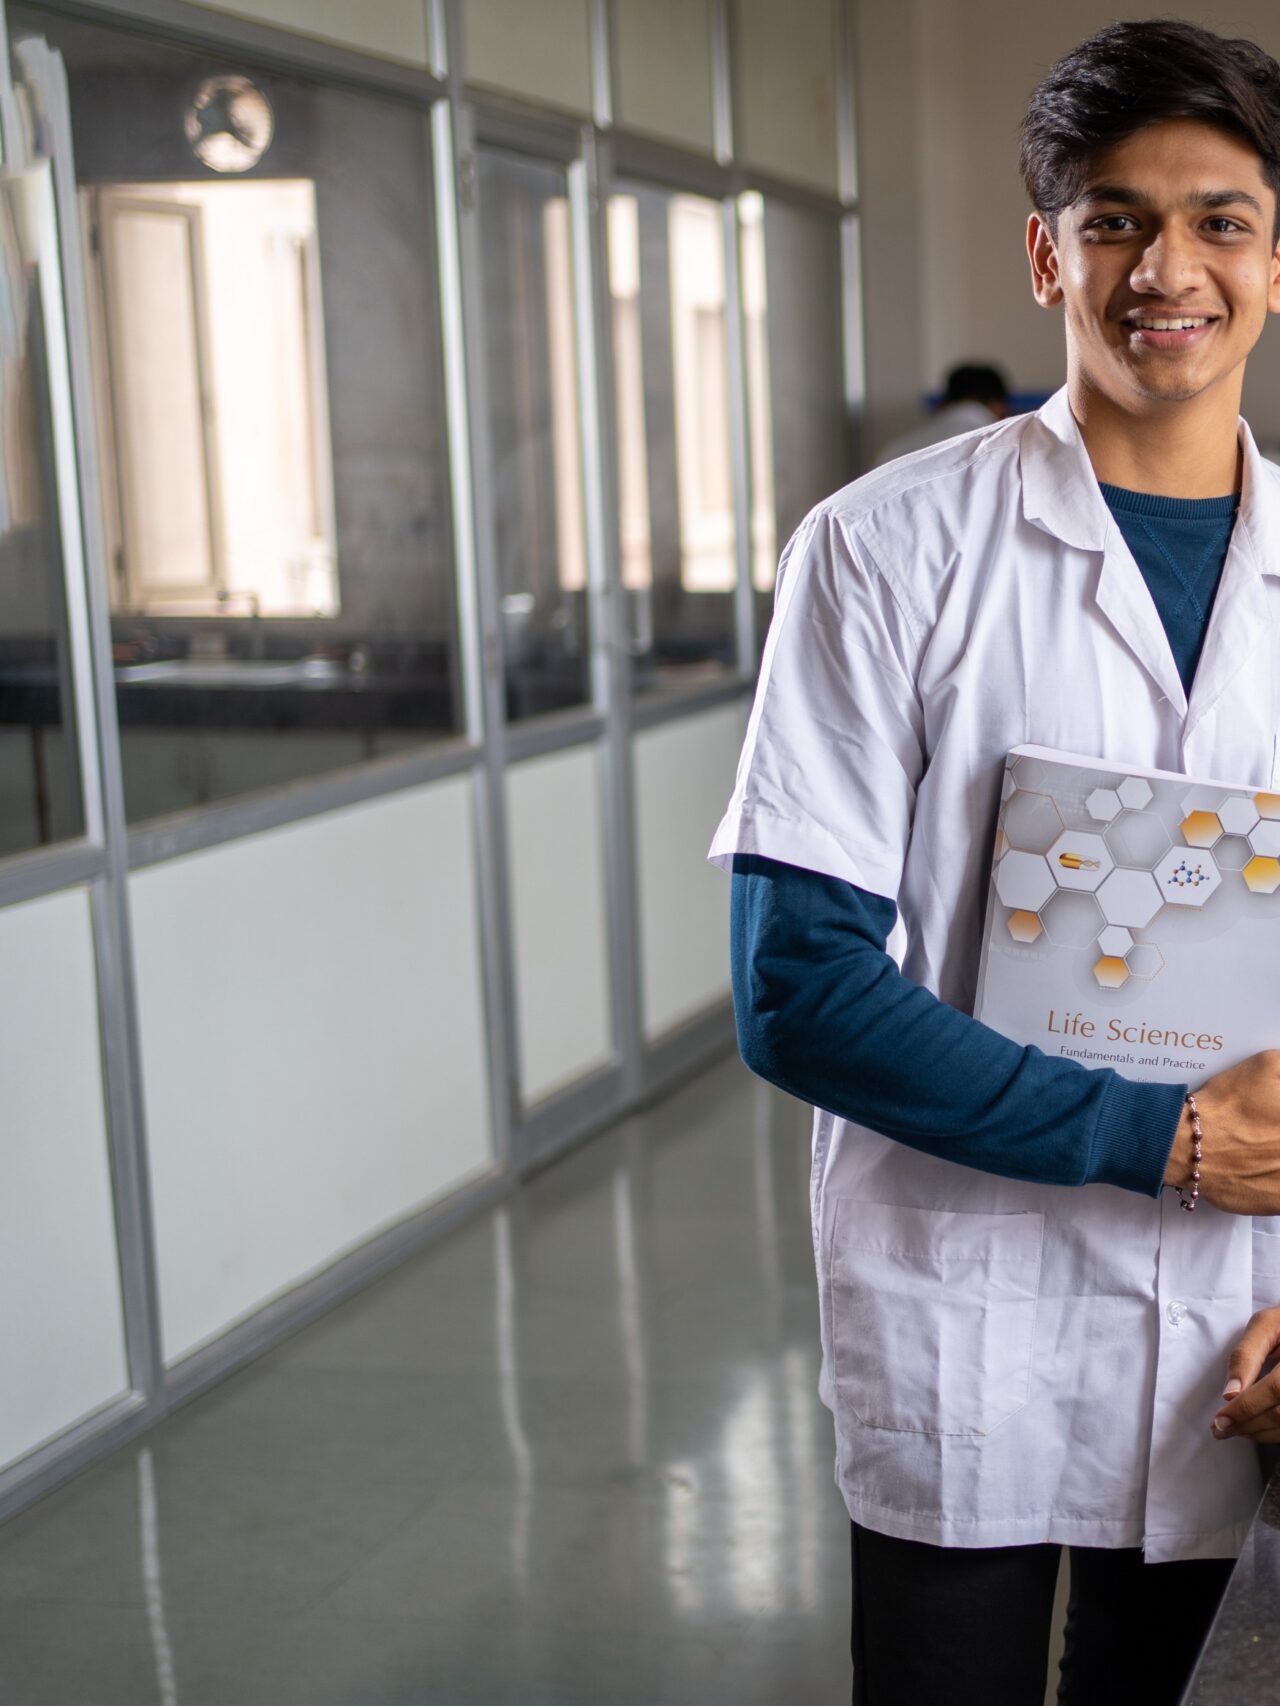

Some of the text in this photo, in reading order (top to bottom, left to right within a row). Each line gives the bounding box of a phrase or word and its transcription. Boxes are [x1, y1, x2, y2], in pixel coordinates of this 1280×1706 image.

[1047, 1010, 1223, 1051] Life Sciences
[1060, 1045, 1206, 1070] Fundamentals and Practice
